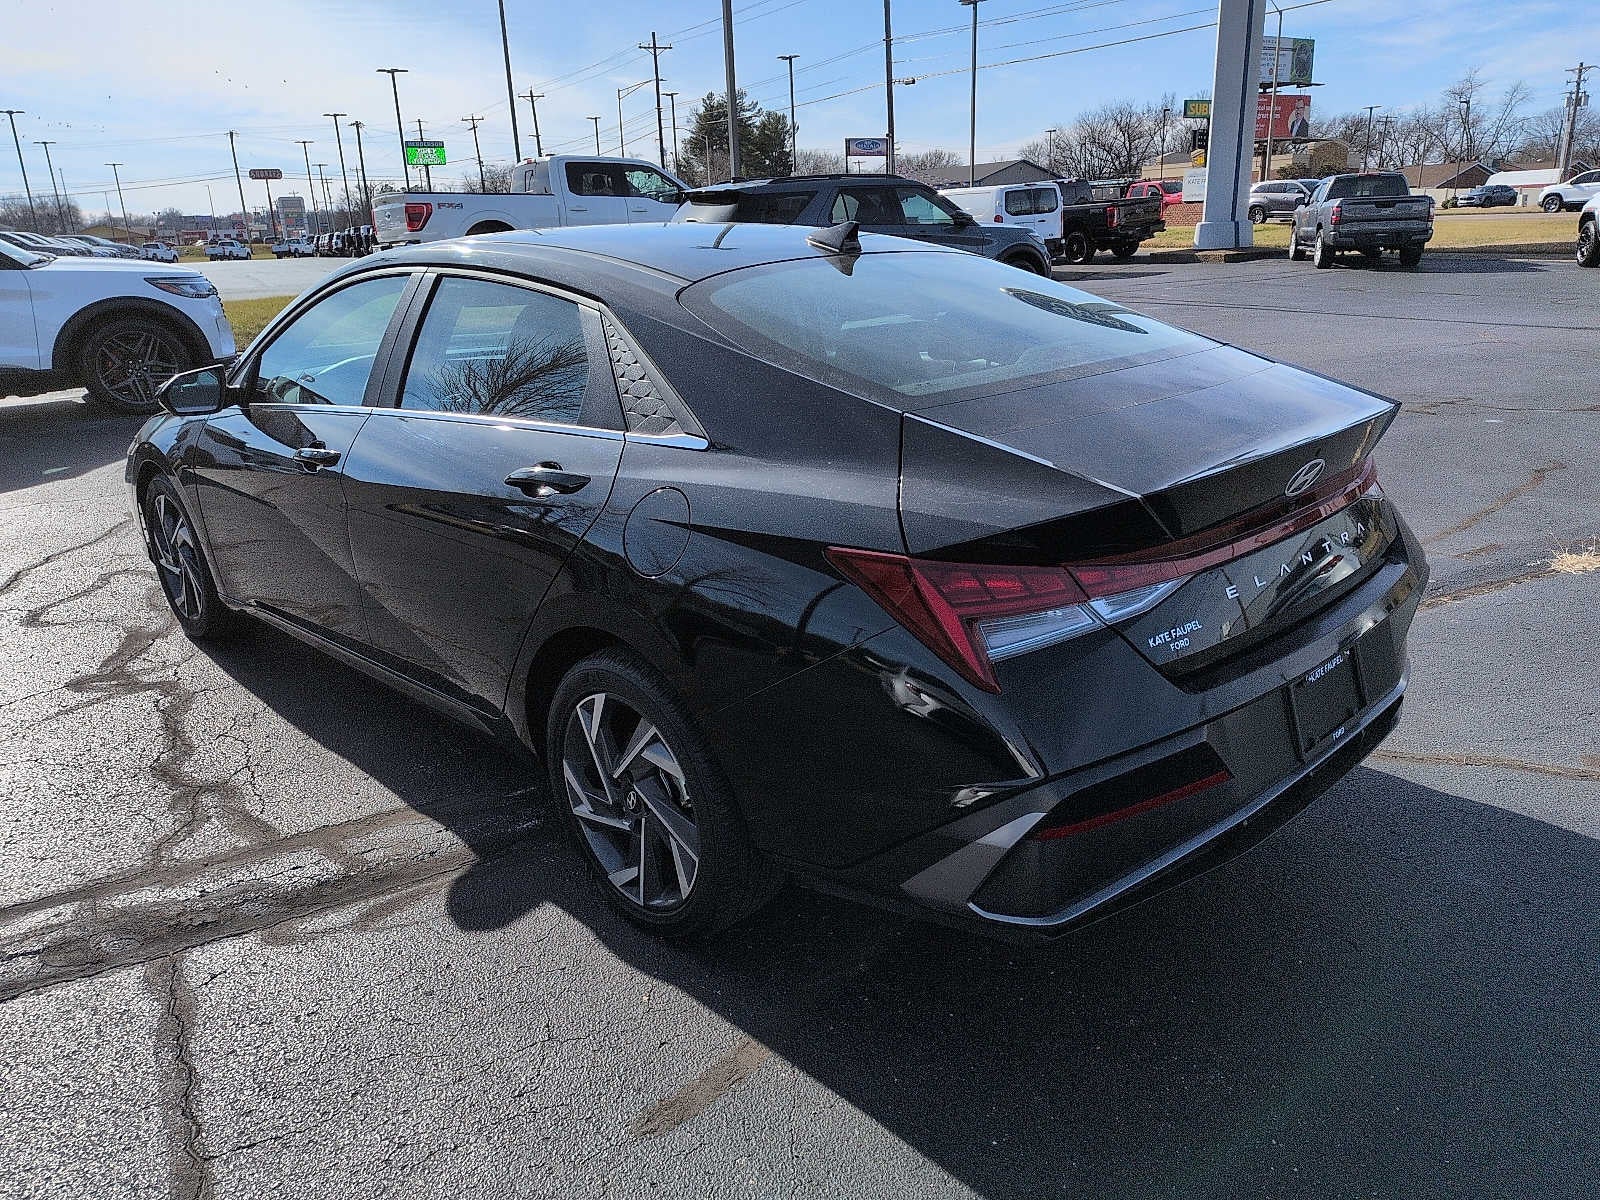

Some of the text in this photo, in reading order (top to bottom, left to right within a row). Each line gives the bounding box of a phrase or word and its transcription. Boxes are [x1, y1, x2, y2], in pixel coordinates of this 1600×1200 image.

[1189, 103, 1212, 114] SUB
[1225, 522, 1365, 600] ELANTRA
[1148, 619, 1203, 648] KATE FAUPEL
[1170, 637, 1190, 652] FORD
[1332, 726, 1345, 741] FORD
